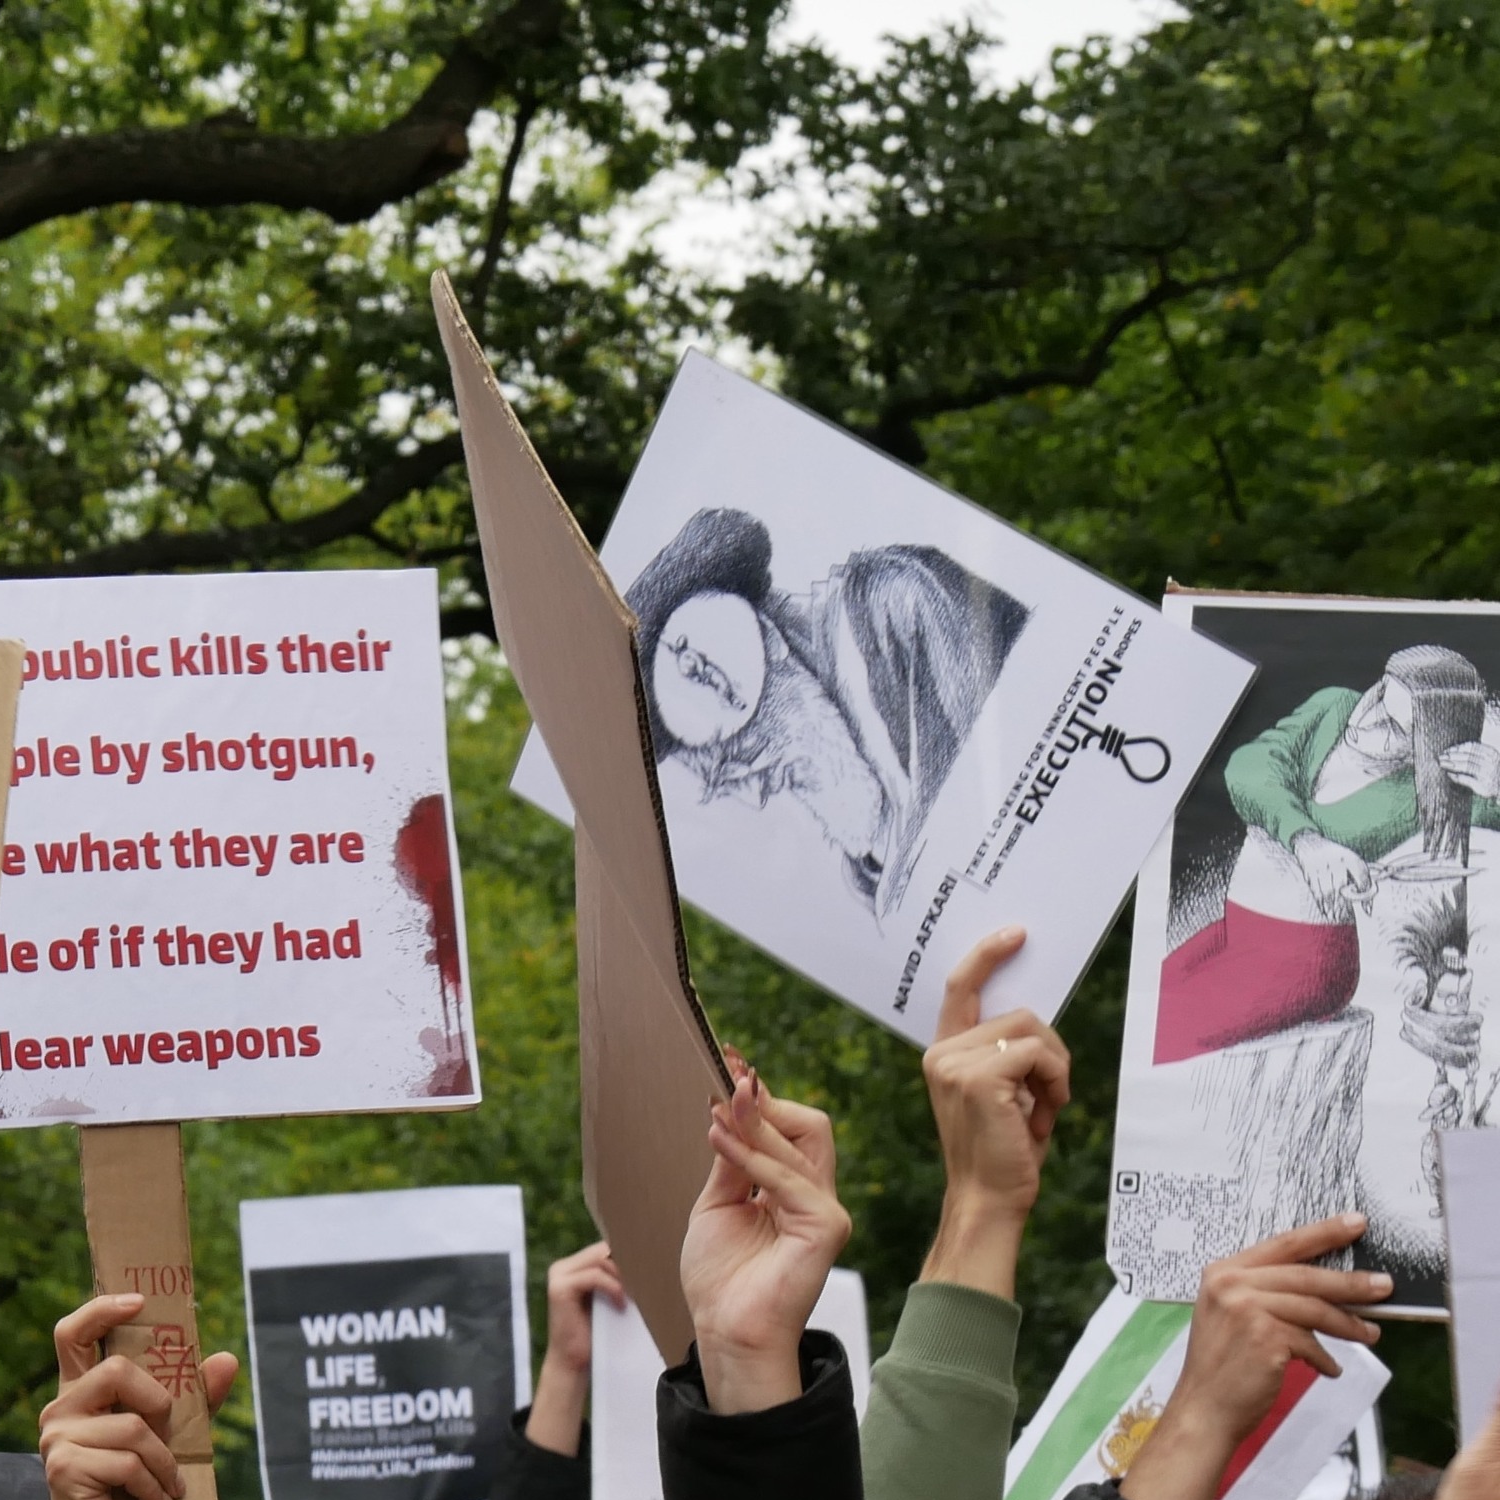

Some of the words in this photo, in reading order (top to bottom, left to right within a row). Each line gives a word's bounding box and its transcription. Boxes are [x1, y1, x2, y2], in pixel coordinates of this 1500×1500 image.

[19, 635, 159, 690] public
[170, 632, 268, 677] kills
[277, 629, 392, 673] their
[990, 770, 1030, 840] LOOKING
[1025, 740, 1047, 770] FOR
[1045, 669, 1087, 742] INNOCENT
[1084, 604, 1125, 668] PEOPLE
[10, 737, 80, 787] ple
[91, 735, 150, 785] by
[162, 732, 376, 782] shotgun,
[984, 852, 1006, 887] FOR
[1015, 656, 1123, 825] EXECUTION
[1113, 617, 1143, 660] ROPES
[35, 831, 161, 875] what
[170, 828, 278, 876] they
[290, 830, 365, 864] are
[48, 927, 99, 971] of
[109, 924, 144, 968] if
[154, 923, 263, 974] they
[273, 919, 362, 963] had
[893, 949, 922, 1014] NAVID
[916, 874, 958, 950] AFKARI
[103, 1024, 321, 1070] weapons
[308, 1386, 474, 1430] FREEDOM
